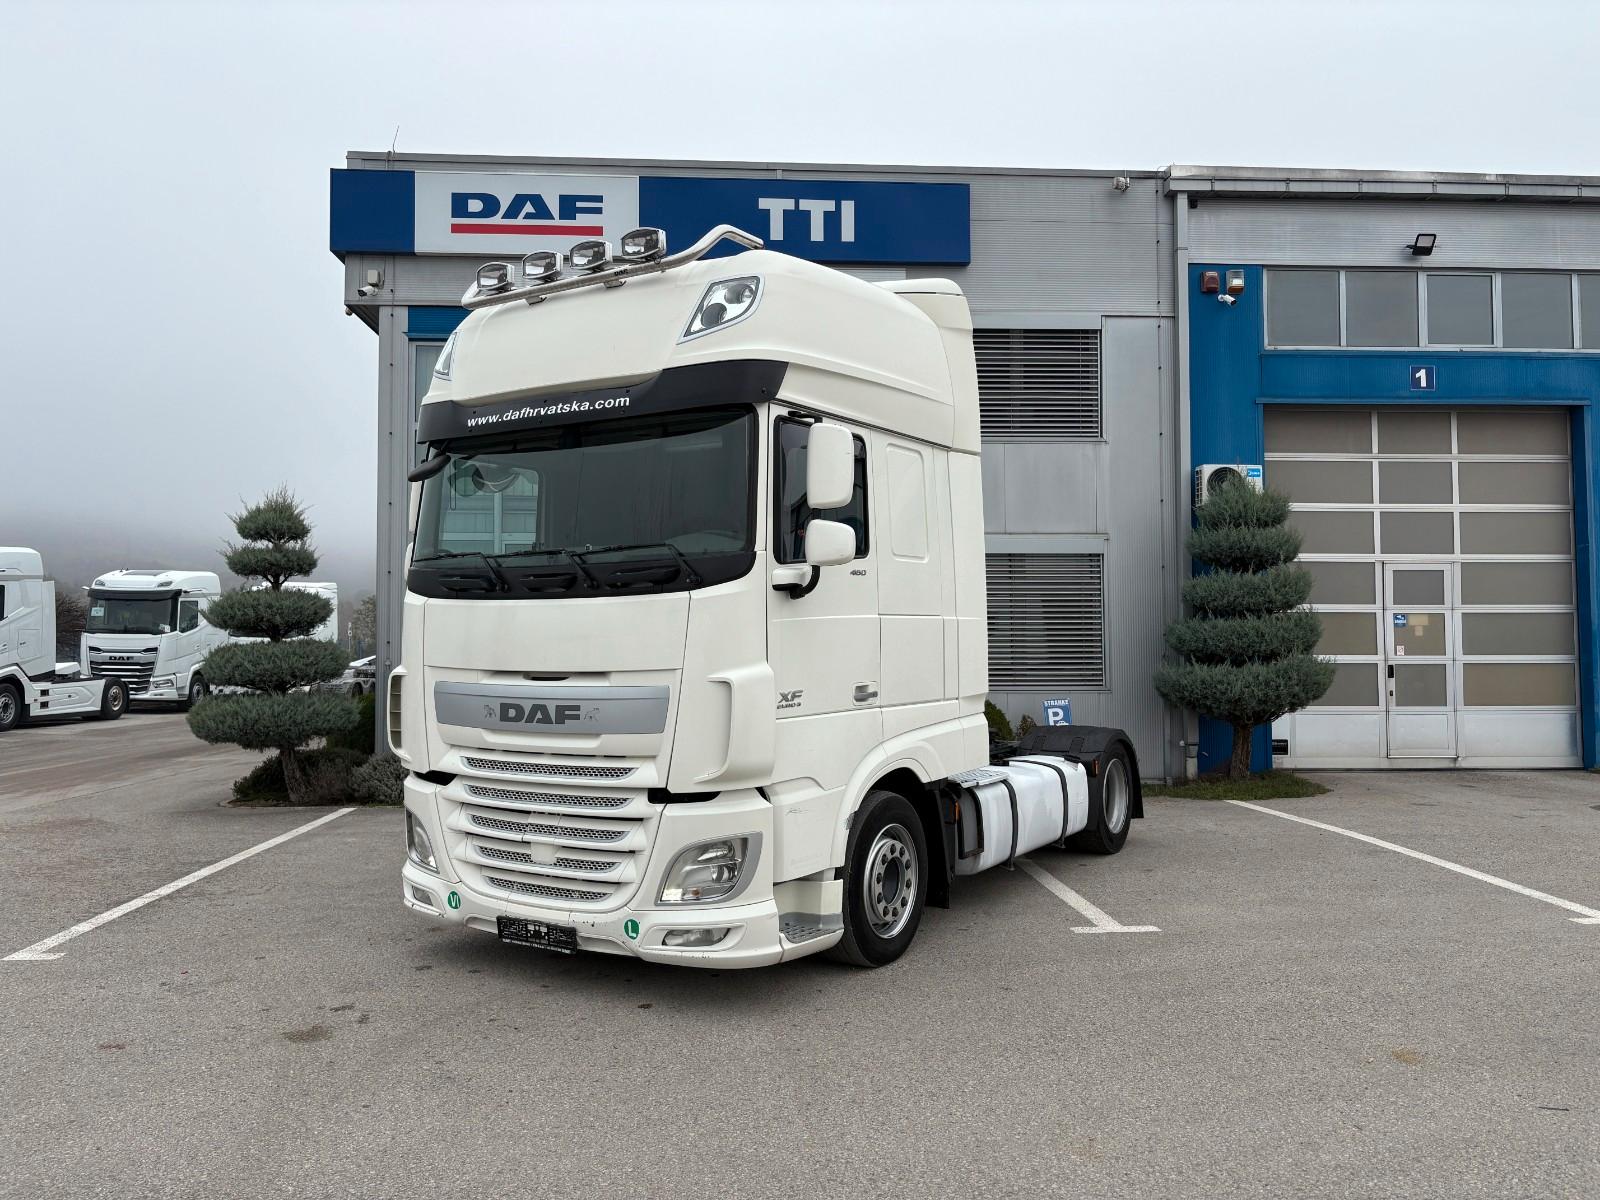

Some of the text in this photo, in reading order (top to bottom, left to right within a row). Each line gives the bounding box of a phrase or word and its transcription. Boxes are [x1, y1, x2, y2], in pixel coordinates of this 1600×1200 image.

[451, 192, 603, 220] DAF
[758, 198, 855, 242] TTI
[1415, 368, 1427, 387] 1
[467, 397, 630, 427] www.dafhrvatska.com
[777, 689, 804, 703] XF
[499, 702, 581, 724] DAF
[1047, 707, 1064, 726] P
[627, 921, 637, 937] L
